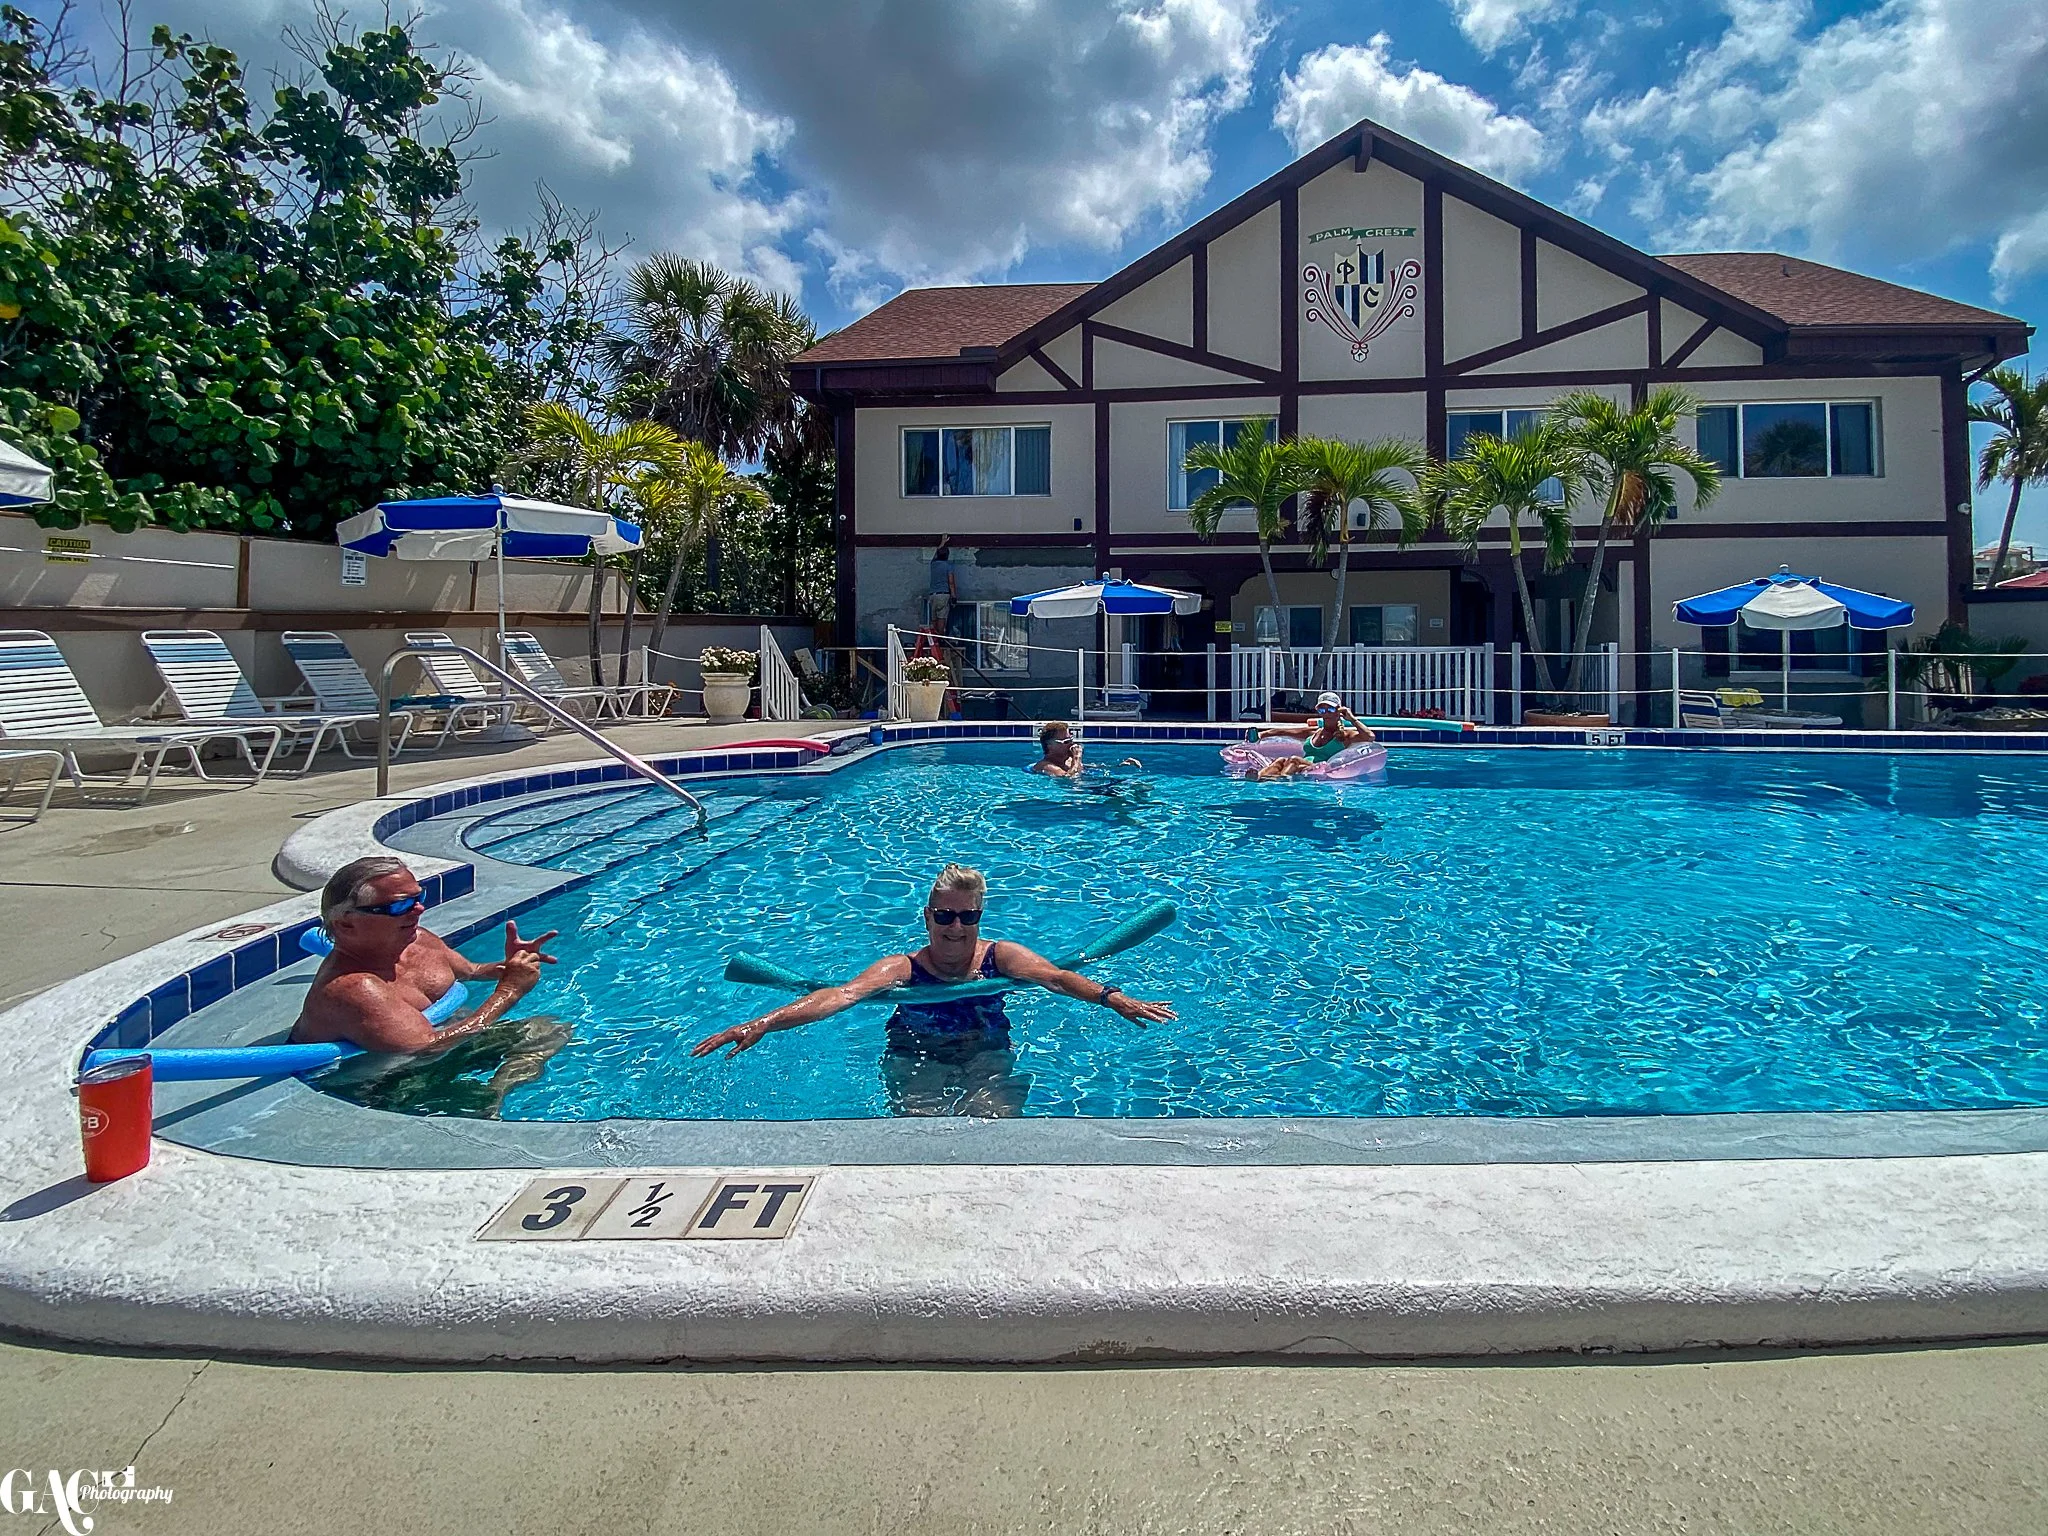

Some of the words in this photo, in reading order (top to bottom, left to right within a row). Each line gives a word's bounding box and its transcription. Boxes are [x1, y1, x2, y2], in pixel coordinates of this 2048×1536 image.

[1316, 228, 1350, 241] PALM
[1365, 228, 1408, 237] CREST
[1336, 258, 1355, 284] P
[1363, 286, 1379, 308] C
[49, 538, 90, 549] CAUTION
[1591, 734, 1600, 745] 5
[1608, 734, 1623, 745] FT
[521, 1185, 587, 1231] 3
[698, 1184, 805, 1229] FT
